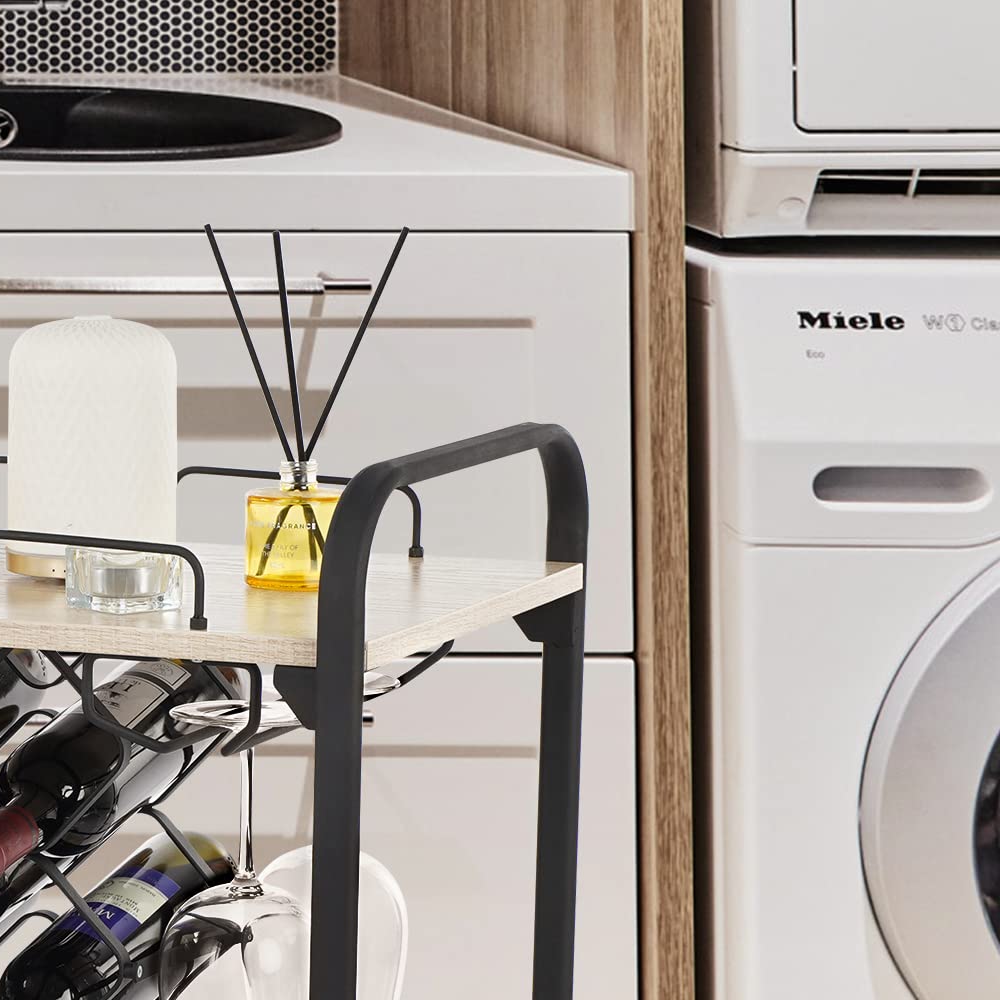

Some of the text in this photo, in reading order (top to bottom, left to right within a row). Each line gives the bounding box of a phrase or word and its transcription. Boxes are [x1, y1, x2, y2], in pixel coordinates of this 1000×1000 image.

[797, 311, 905, 330] Miele
[970, 316, 1000, 331] Cla
[806, 349, 825, 359] Eco
[267, 522, 317, 530] RAGRANCE
